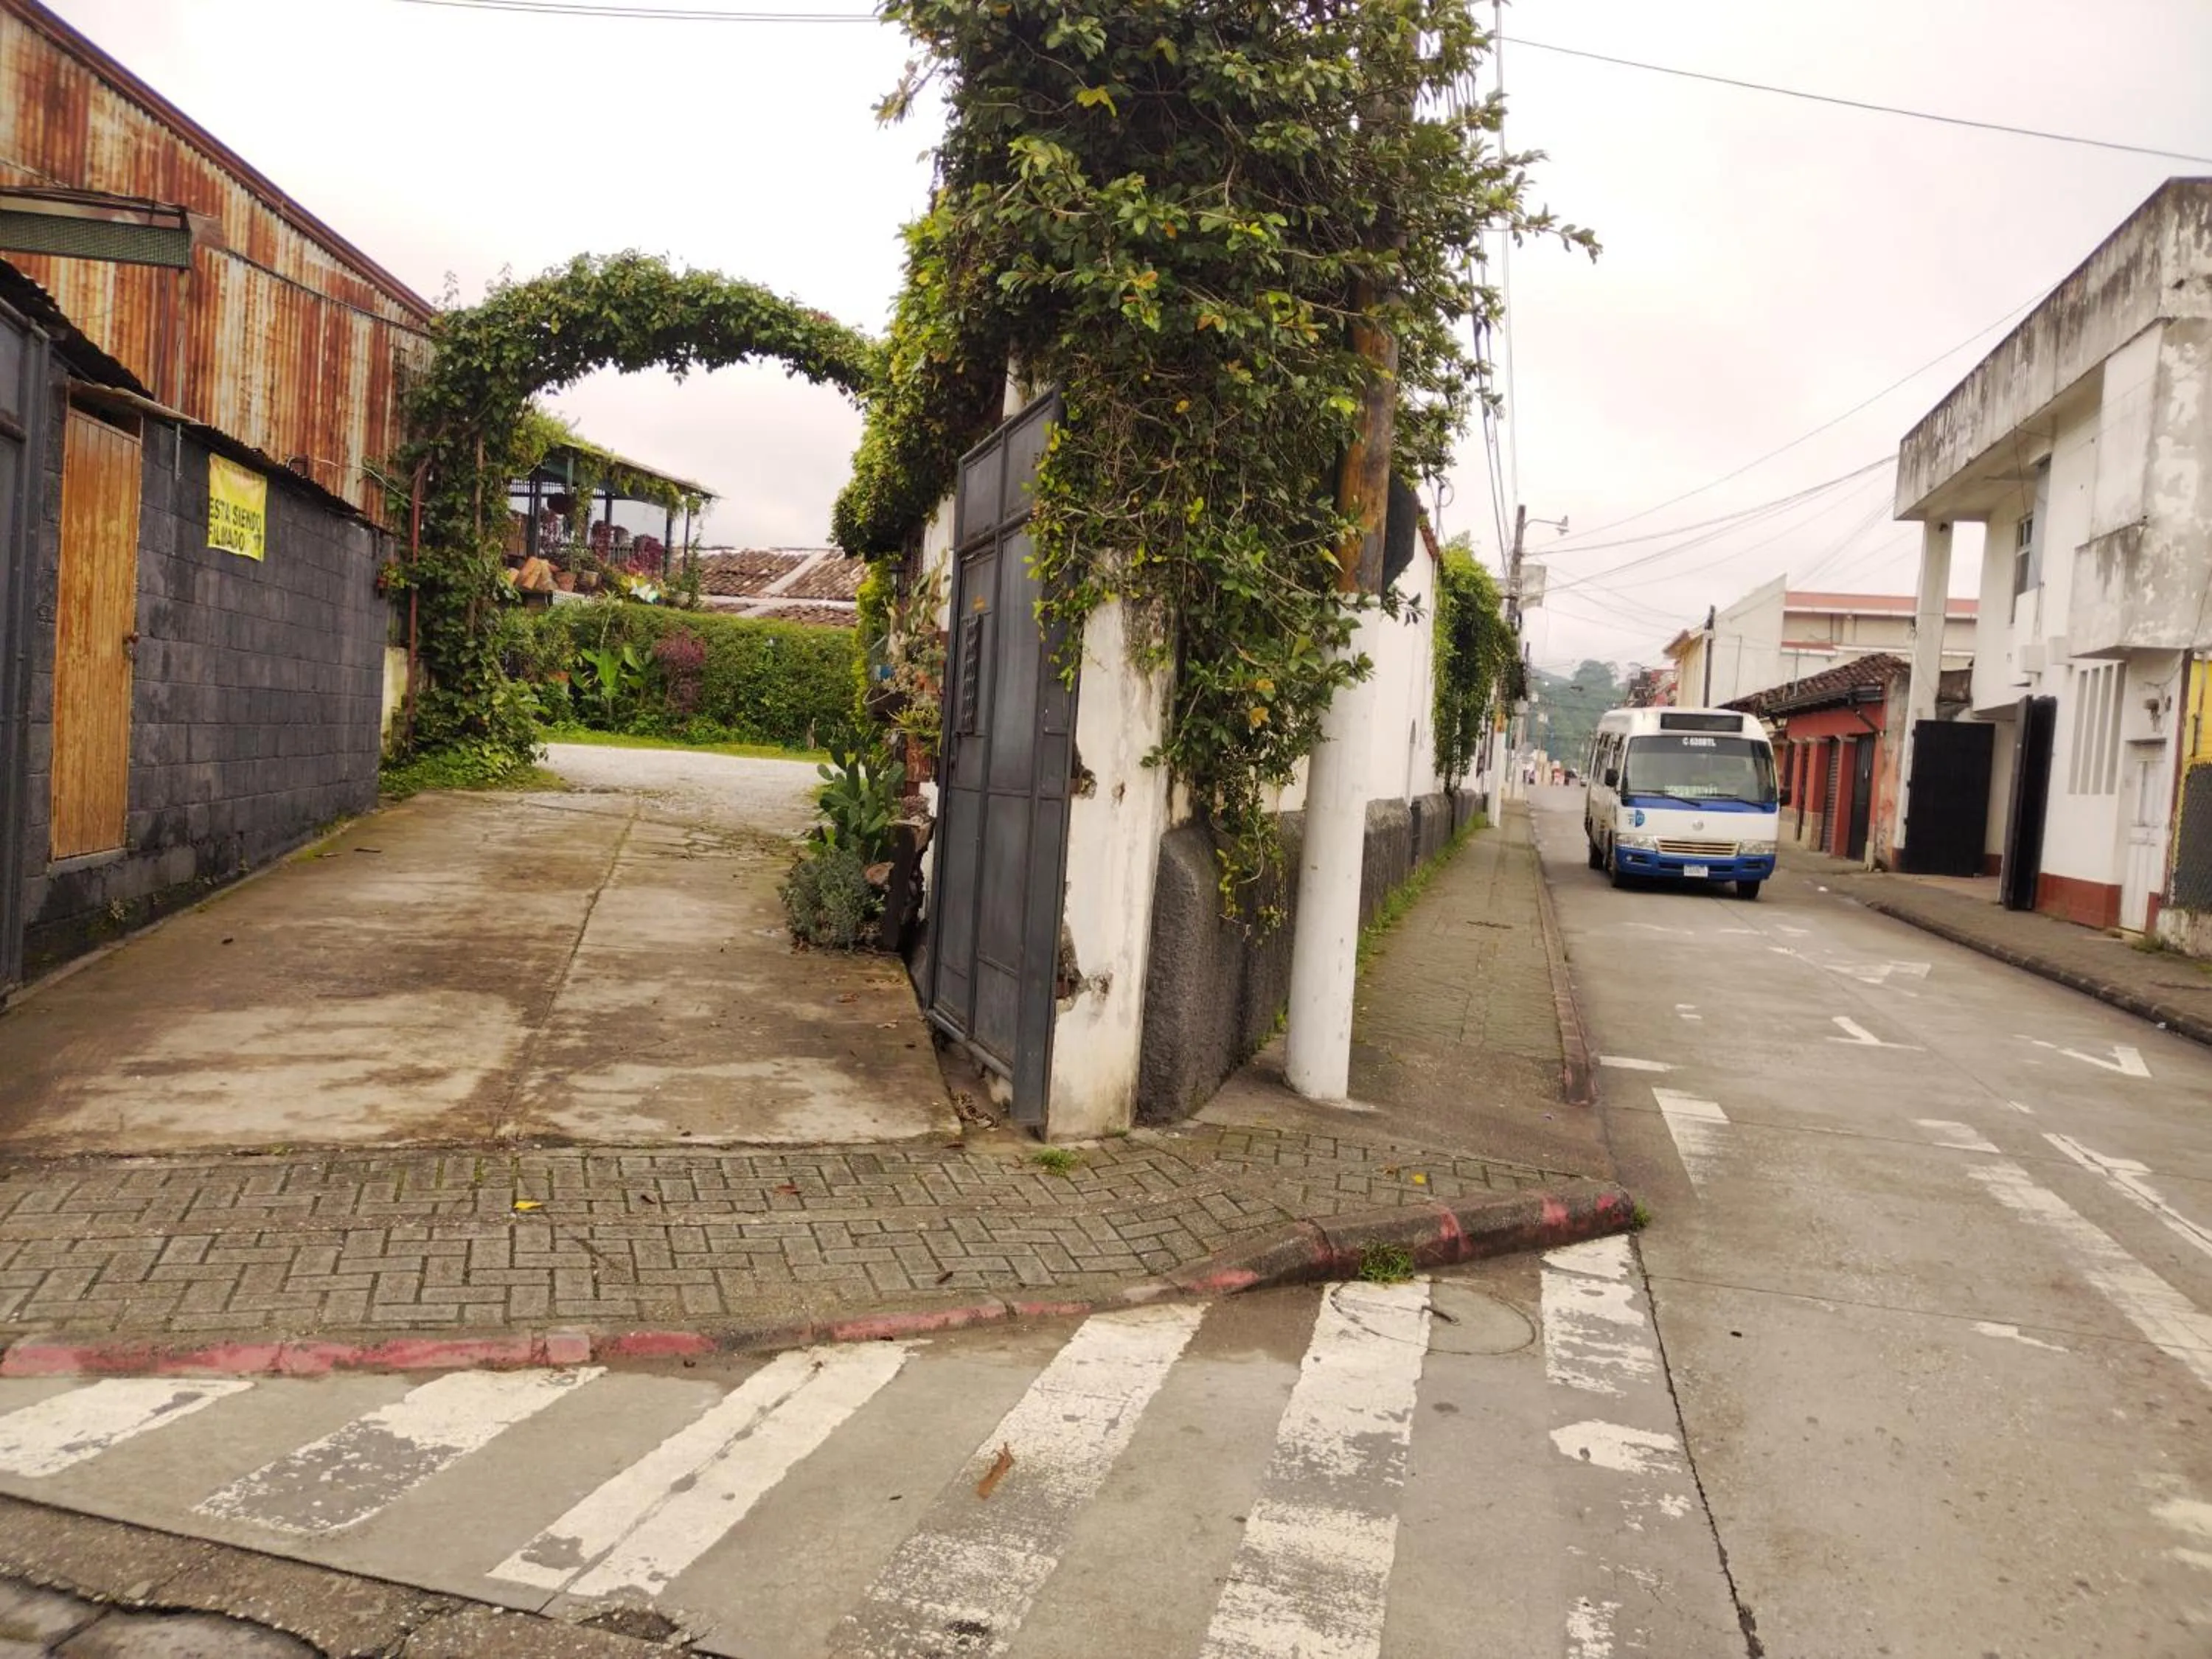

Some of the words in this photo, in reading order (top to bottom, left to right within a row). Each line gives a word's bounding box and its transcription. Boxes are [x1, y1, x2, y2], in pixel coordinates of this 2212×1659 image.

[209, 496, 230, 523] ESTA
[232, 505, 261, 532] SIENDO
[209, 522, 245, 552] FILMADO
